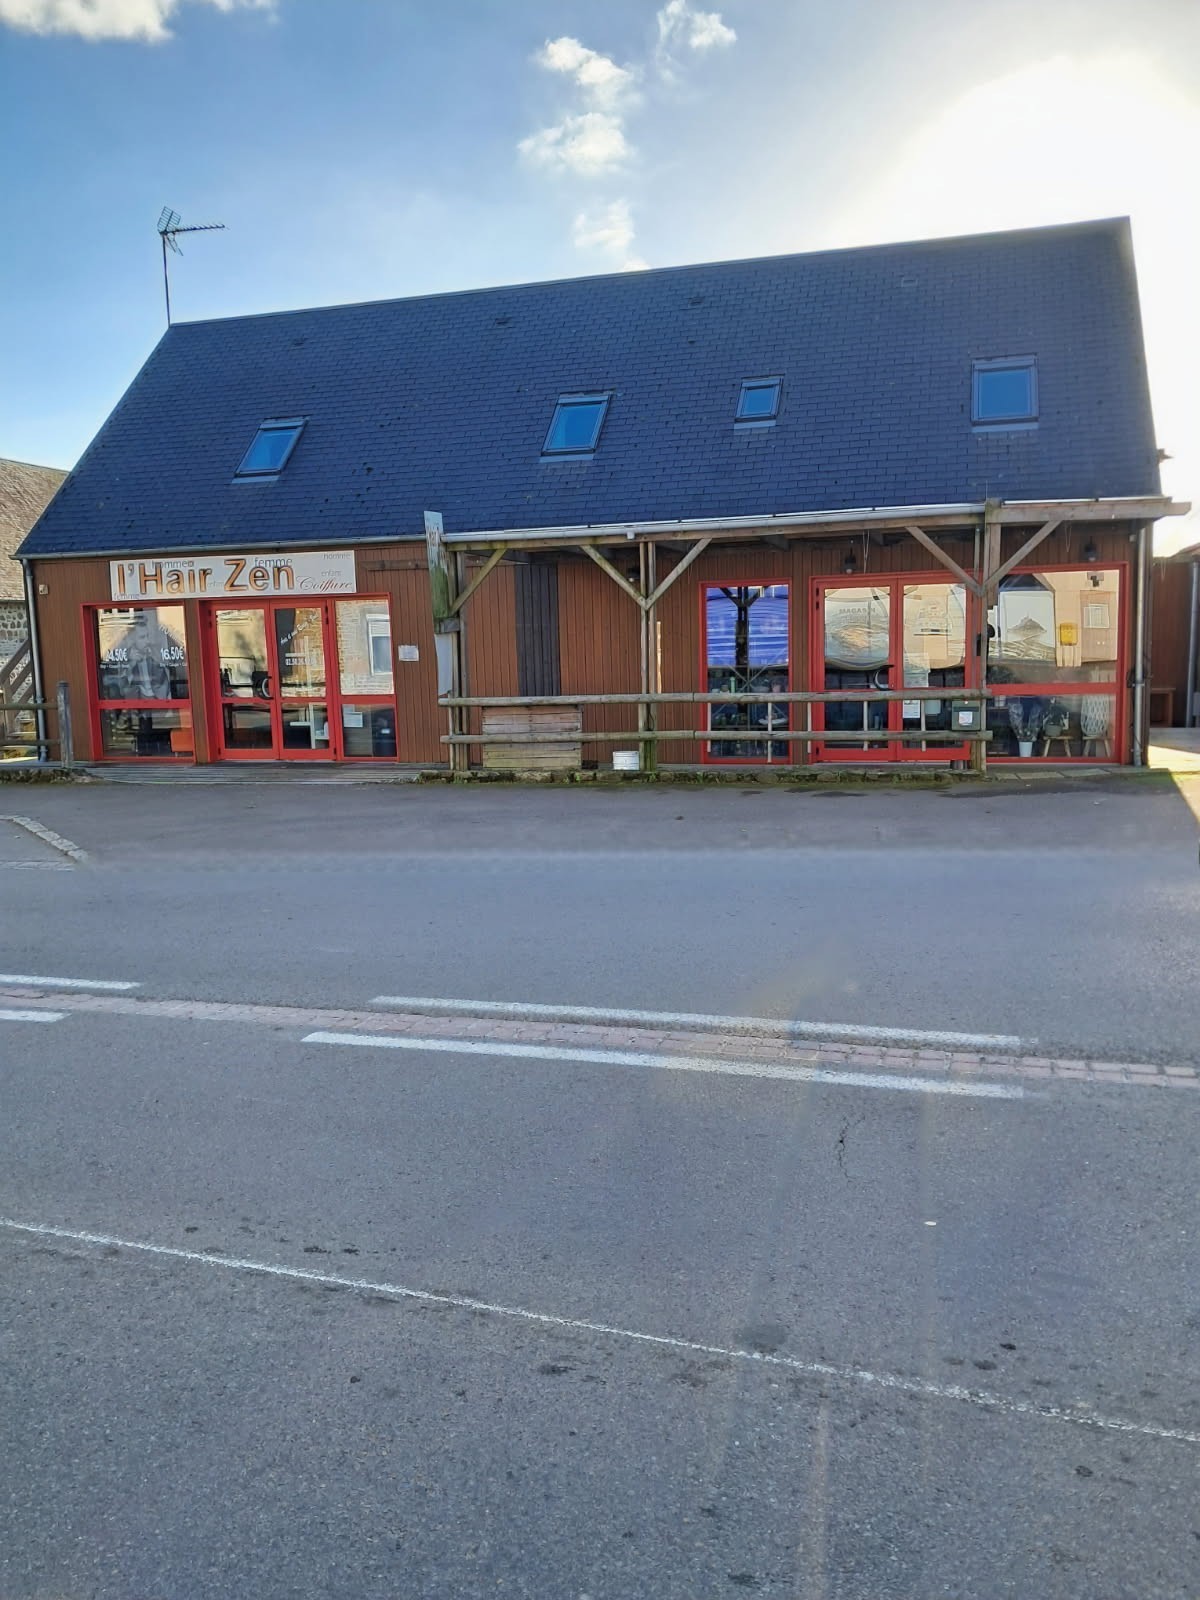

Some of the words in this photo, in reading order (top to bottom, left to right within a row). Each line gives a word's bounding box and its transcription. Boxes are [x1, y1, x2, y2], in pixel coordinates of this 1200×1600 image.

[254, 557, 293, 568] femme
[224, 558, 295, 592] Zen
[297, 575, 353, 592] Coiffure
